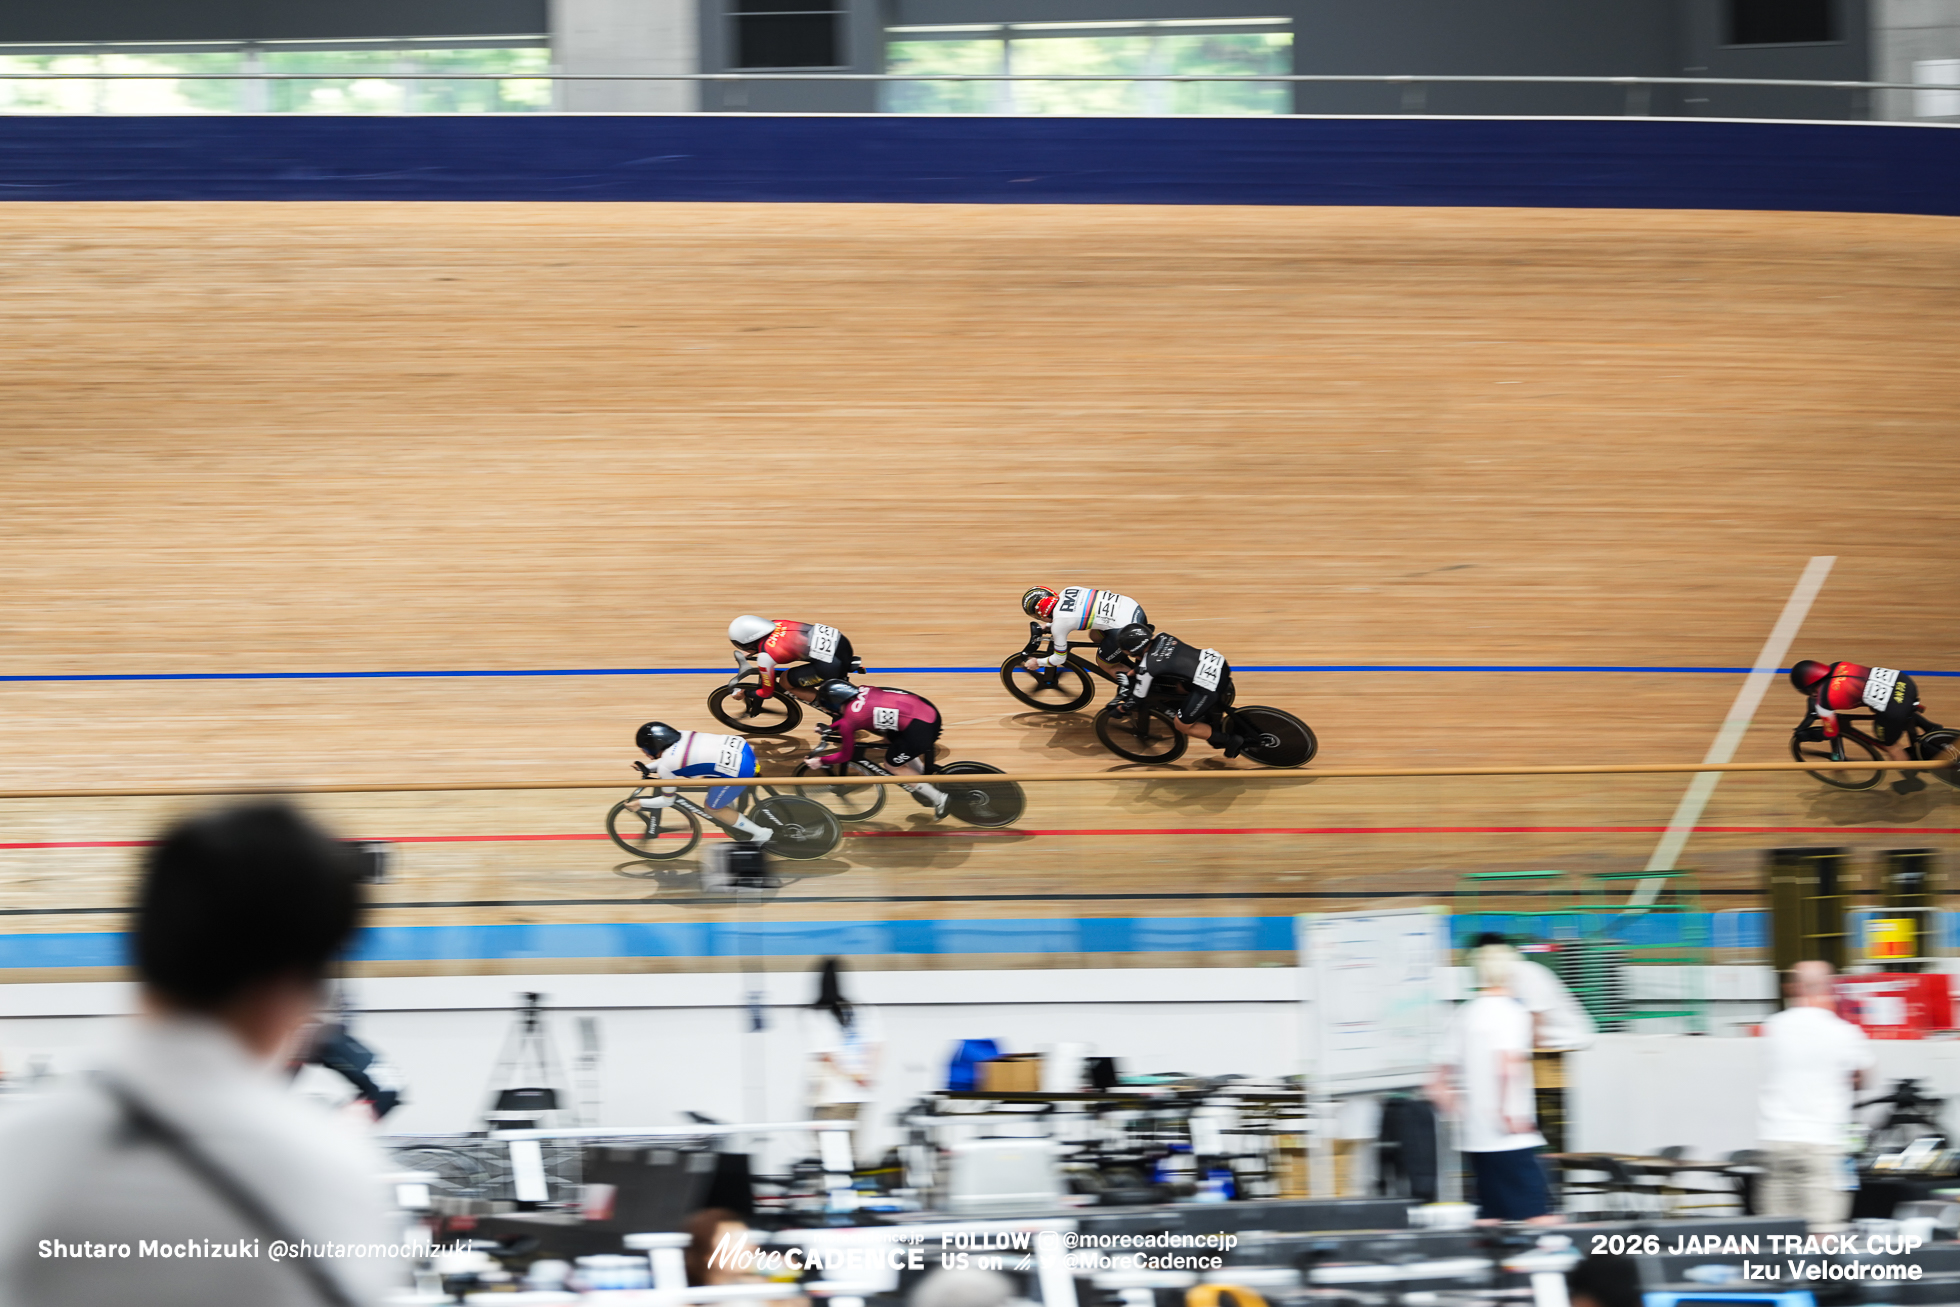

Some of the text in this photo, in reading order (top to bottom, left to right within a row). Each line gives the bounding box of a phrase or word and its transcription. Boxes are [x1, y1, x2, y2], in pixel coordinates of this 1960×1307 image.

[1098, 601, 1115, 617] 141
[815, 636, 832, 653] 132
[1199, 663, 1217, 681] 144
[720, 750, 738, 768] 131
